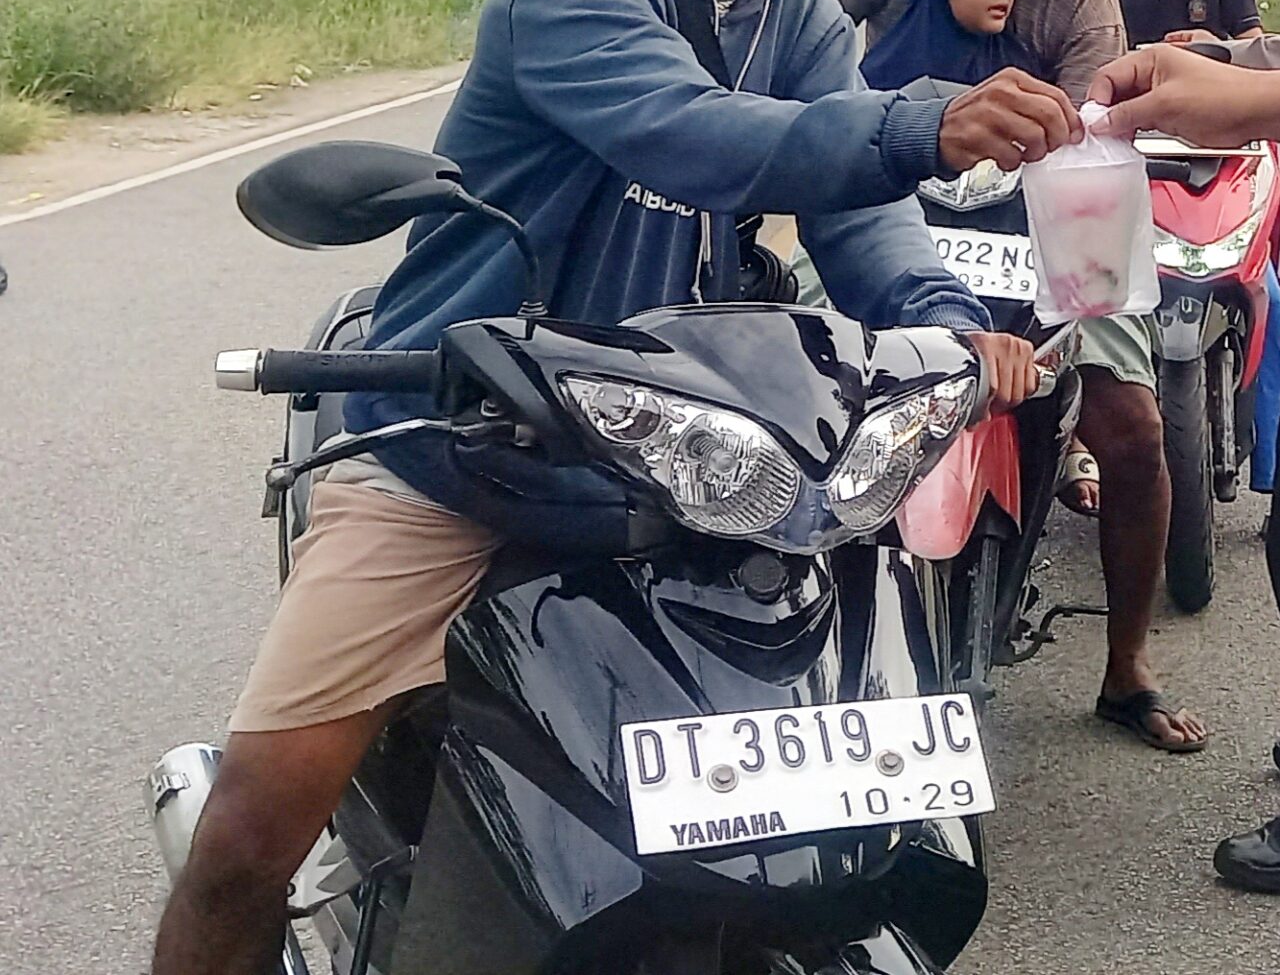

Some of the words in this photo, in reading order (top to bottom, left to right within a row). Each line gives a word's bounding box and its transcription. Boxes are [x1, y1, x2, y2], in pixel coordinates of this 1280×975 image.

[936, 238, 993, 266] 022
[633, 723, 703, 786] DT
[732, 709, 873, 773] 3619
[911, 700, 972, 757] JC
[670, 810, 787, 846] YAMAHA
